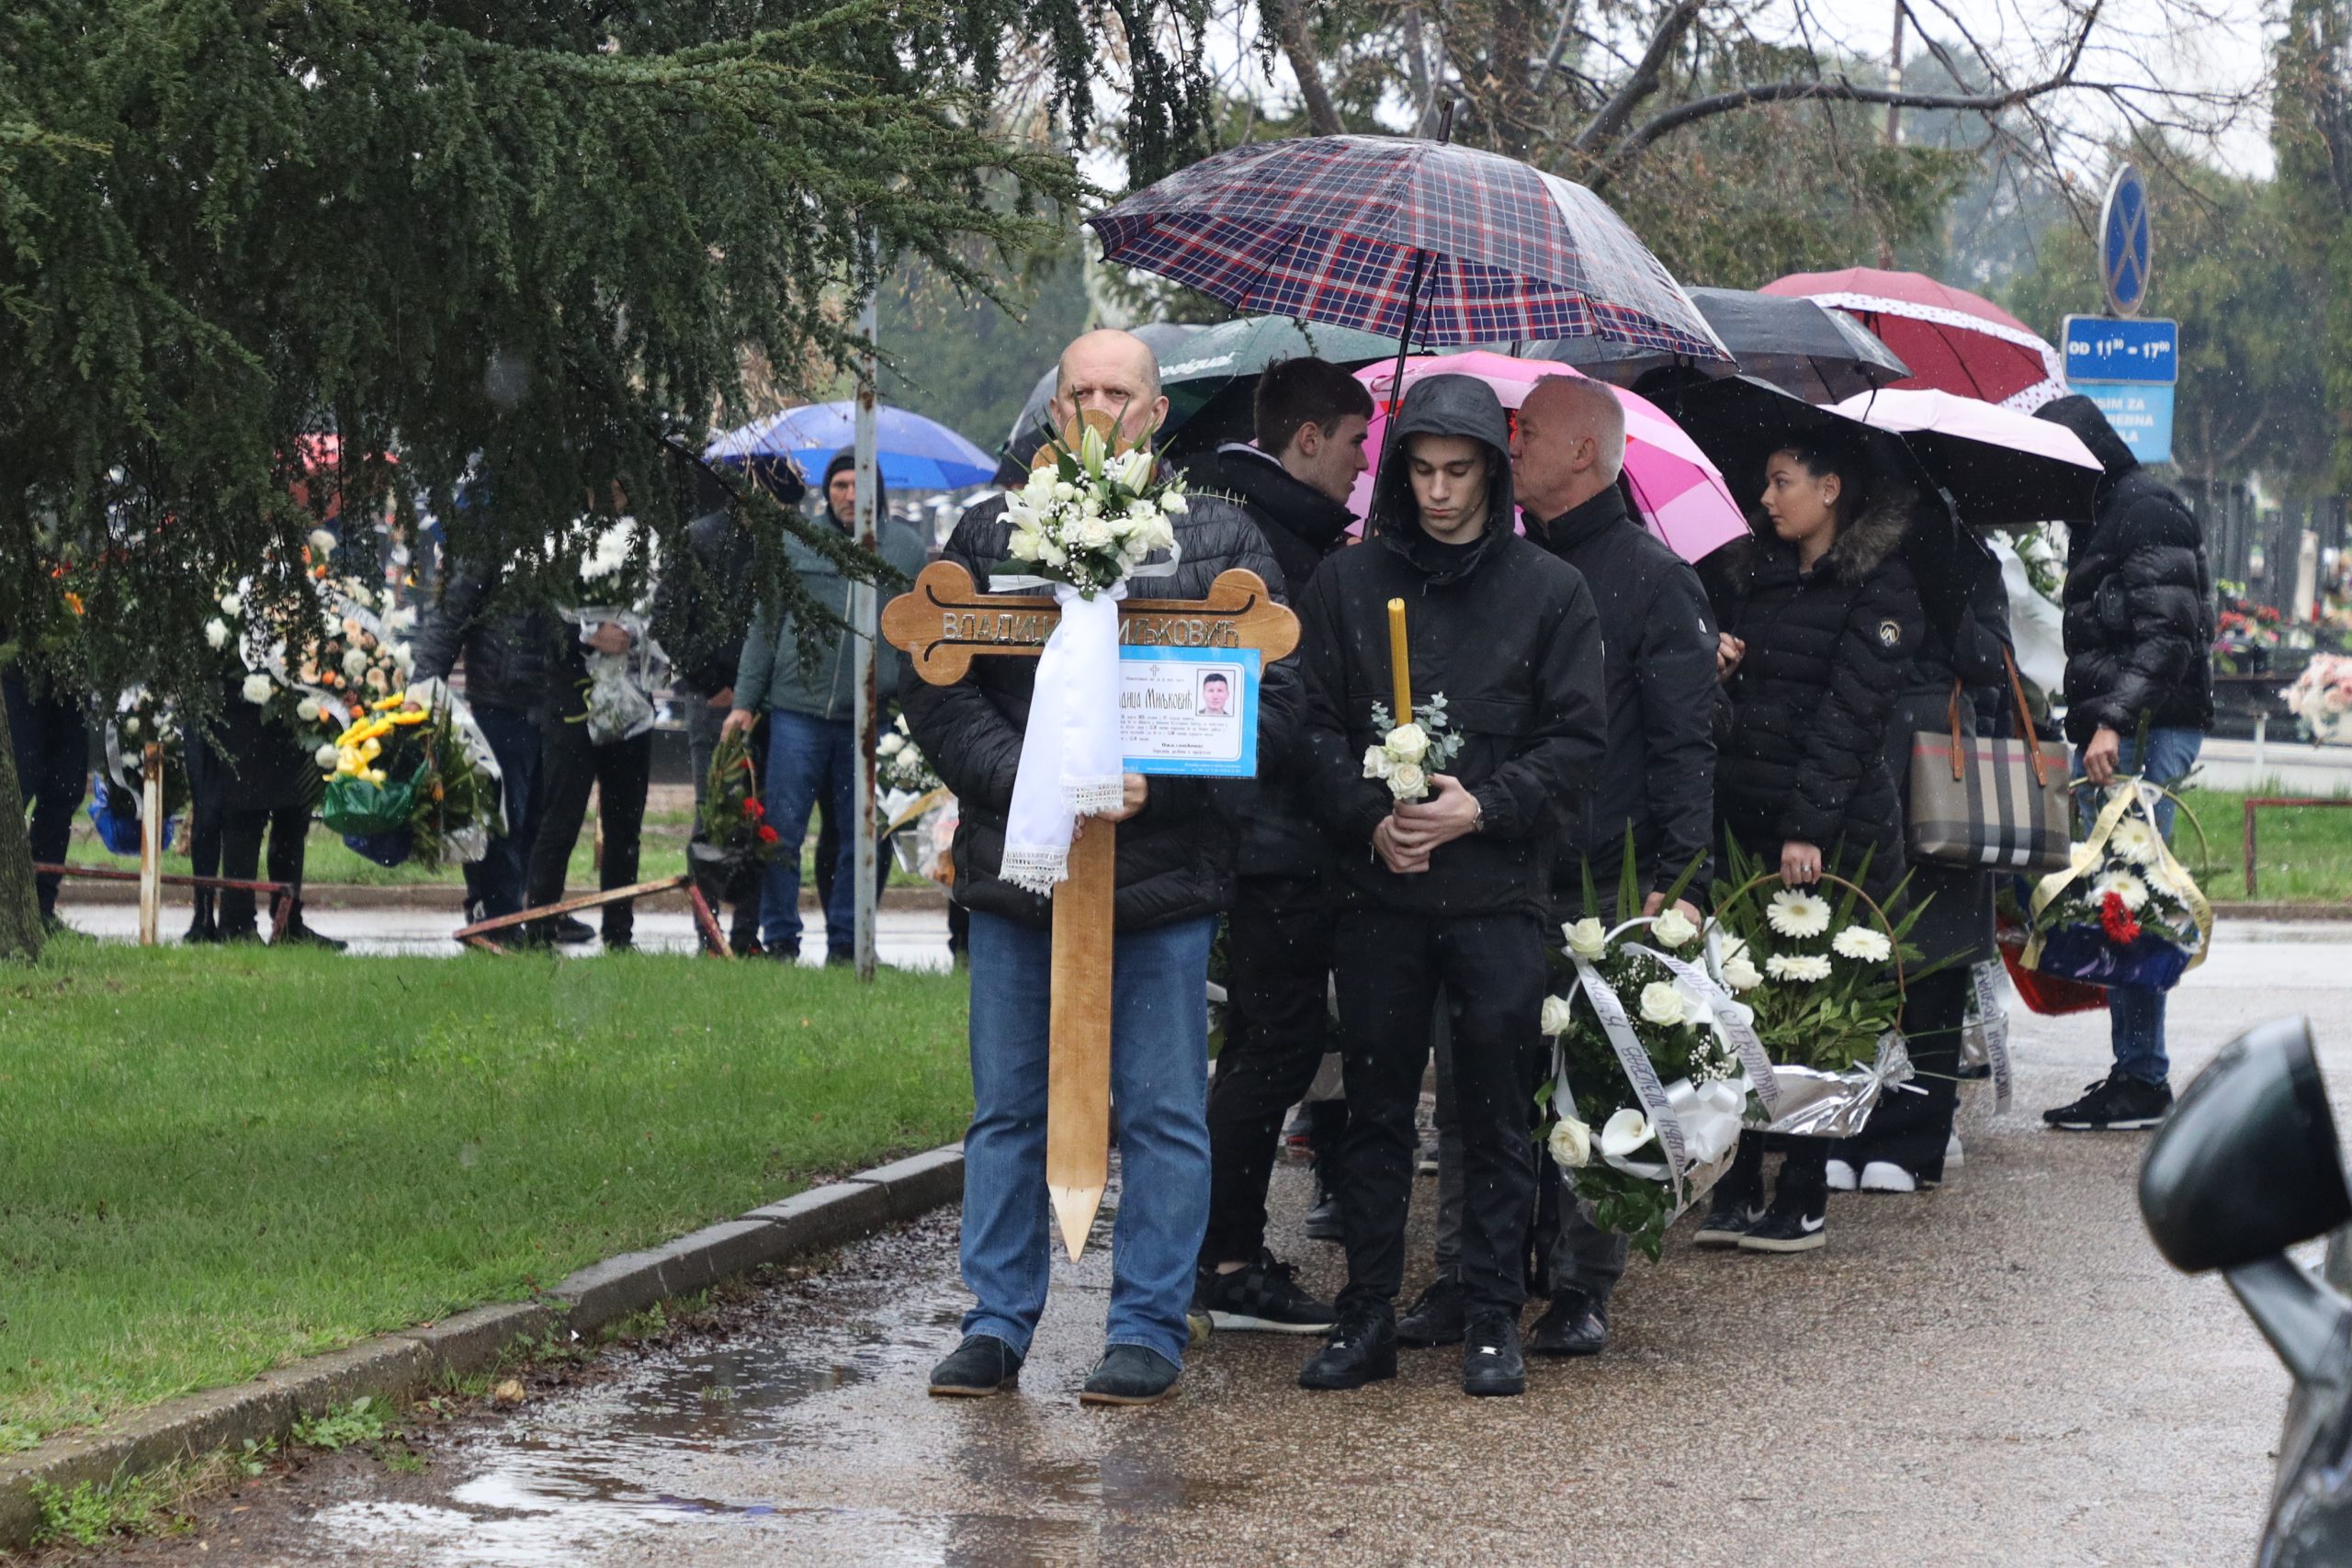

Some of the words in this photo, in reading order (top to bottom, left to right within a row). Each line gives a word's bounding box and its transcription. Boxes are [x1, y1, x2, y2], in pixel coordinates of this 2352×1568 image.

[2069, 341, 2090, 355] OD
[943, 613, 1048, 645] ВЛАДИЦ
[1118, 617, 1238, 648] ИЉКОВИЋ
